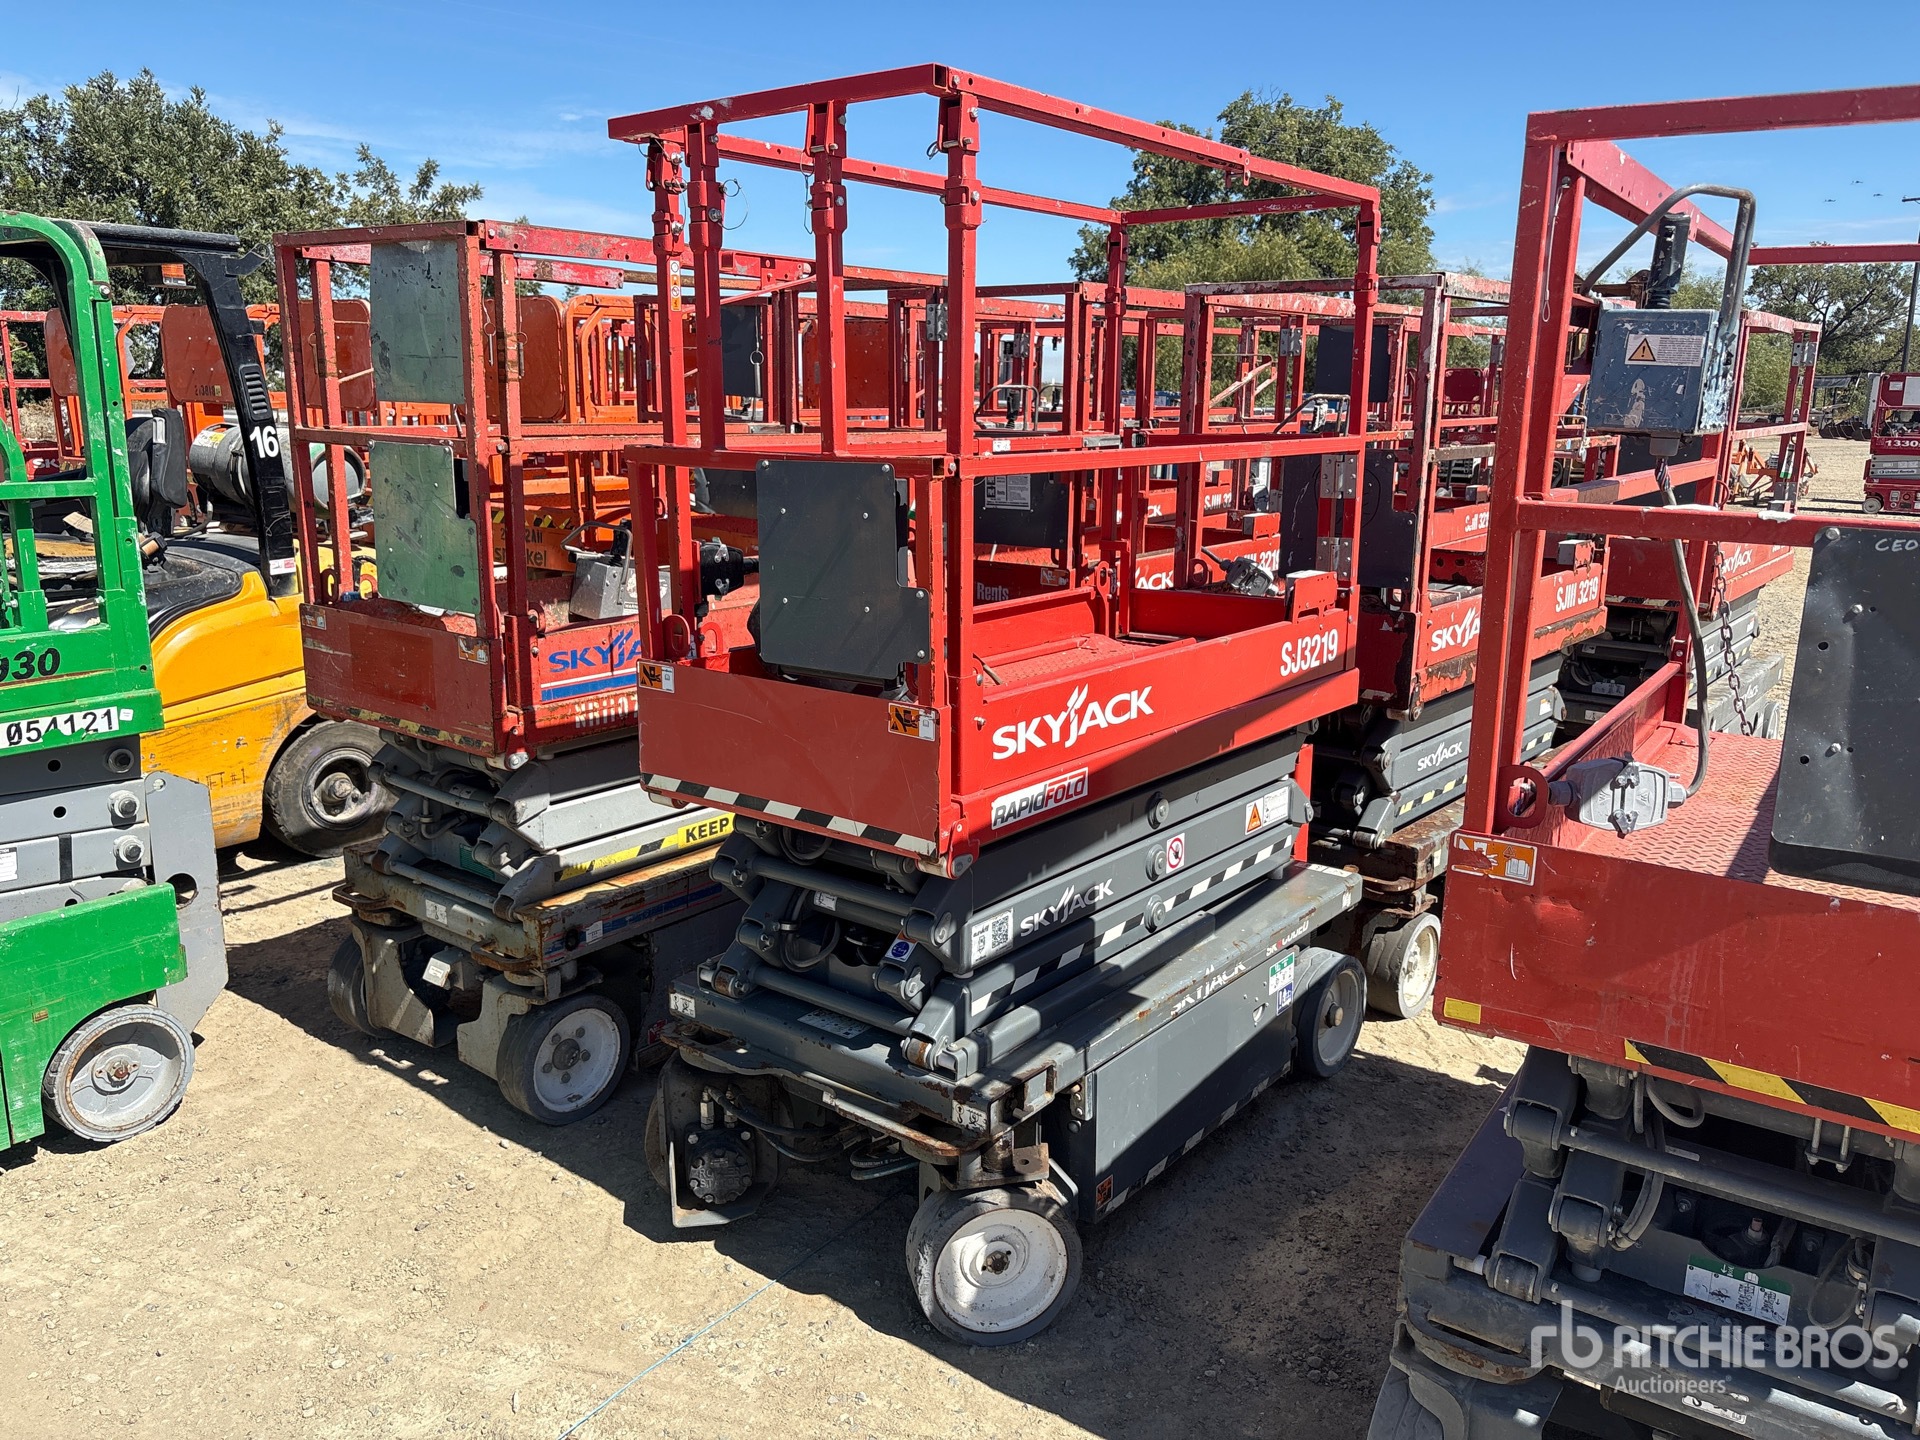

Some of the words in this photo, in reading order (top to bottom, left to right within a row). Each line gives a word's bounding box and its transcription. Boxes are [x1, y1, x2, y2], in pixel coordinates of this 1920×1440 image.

[250, 425, 279, 459] 16
[1874, 538, 1919, 552] CEO
[976, 581, 1009, 602] Rents
[1578, 576, 1599, 605] 3219
[1280, 629, 1339, 677] SJ3219
[992, 684, 1154, 760] SKYJACK
[1417, 742, 1463, 771] SKYJACK
[685, 817, 729, 843] KEEP
[1020, 878, 1114, 937] SKYJACK
